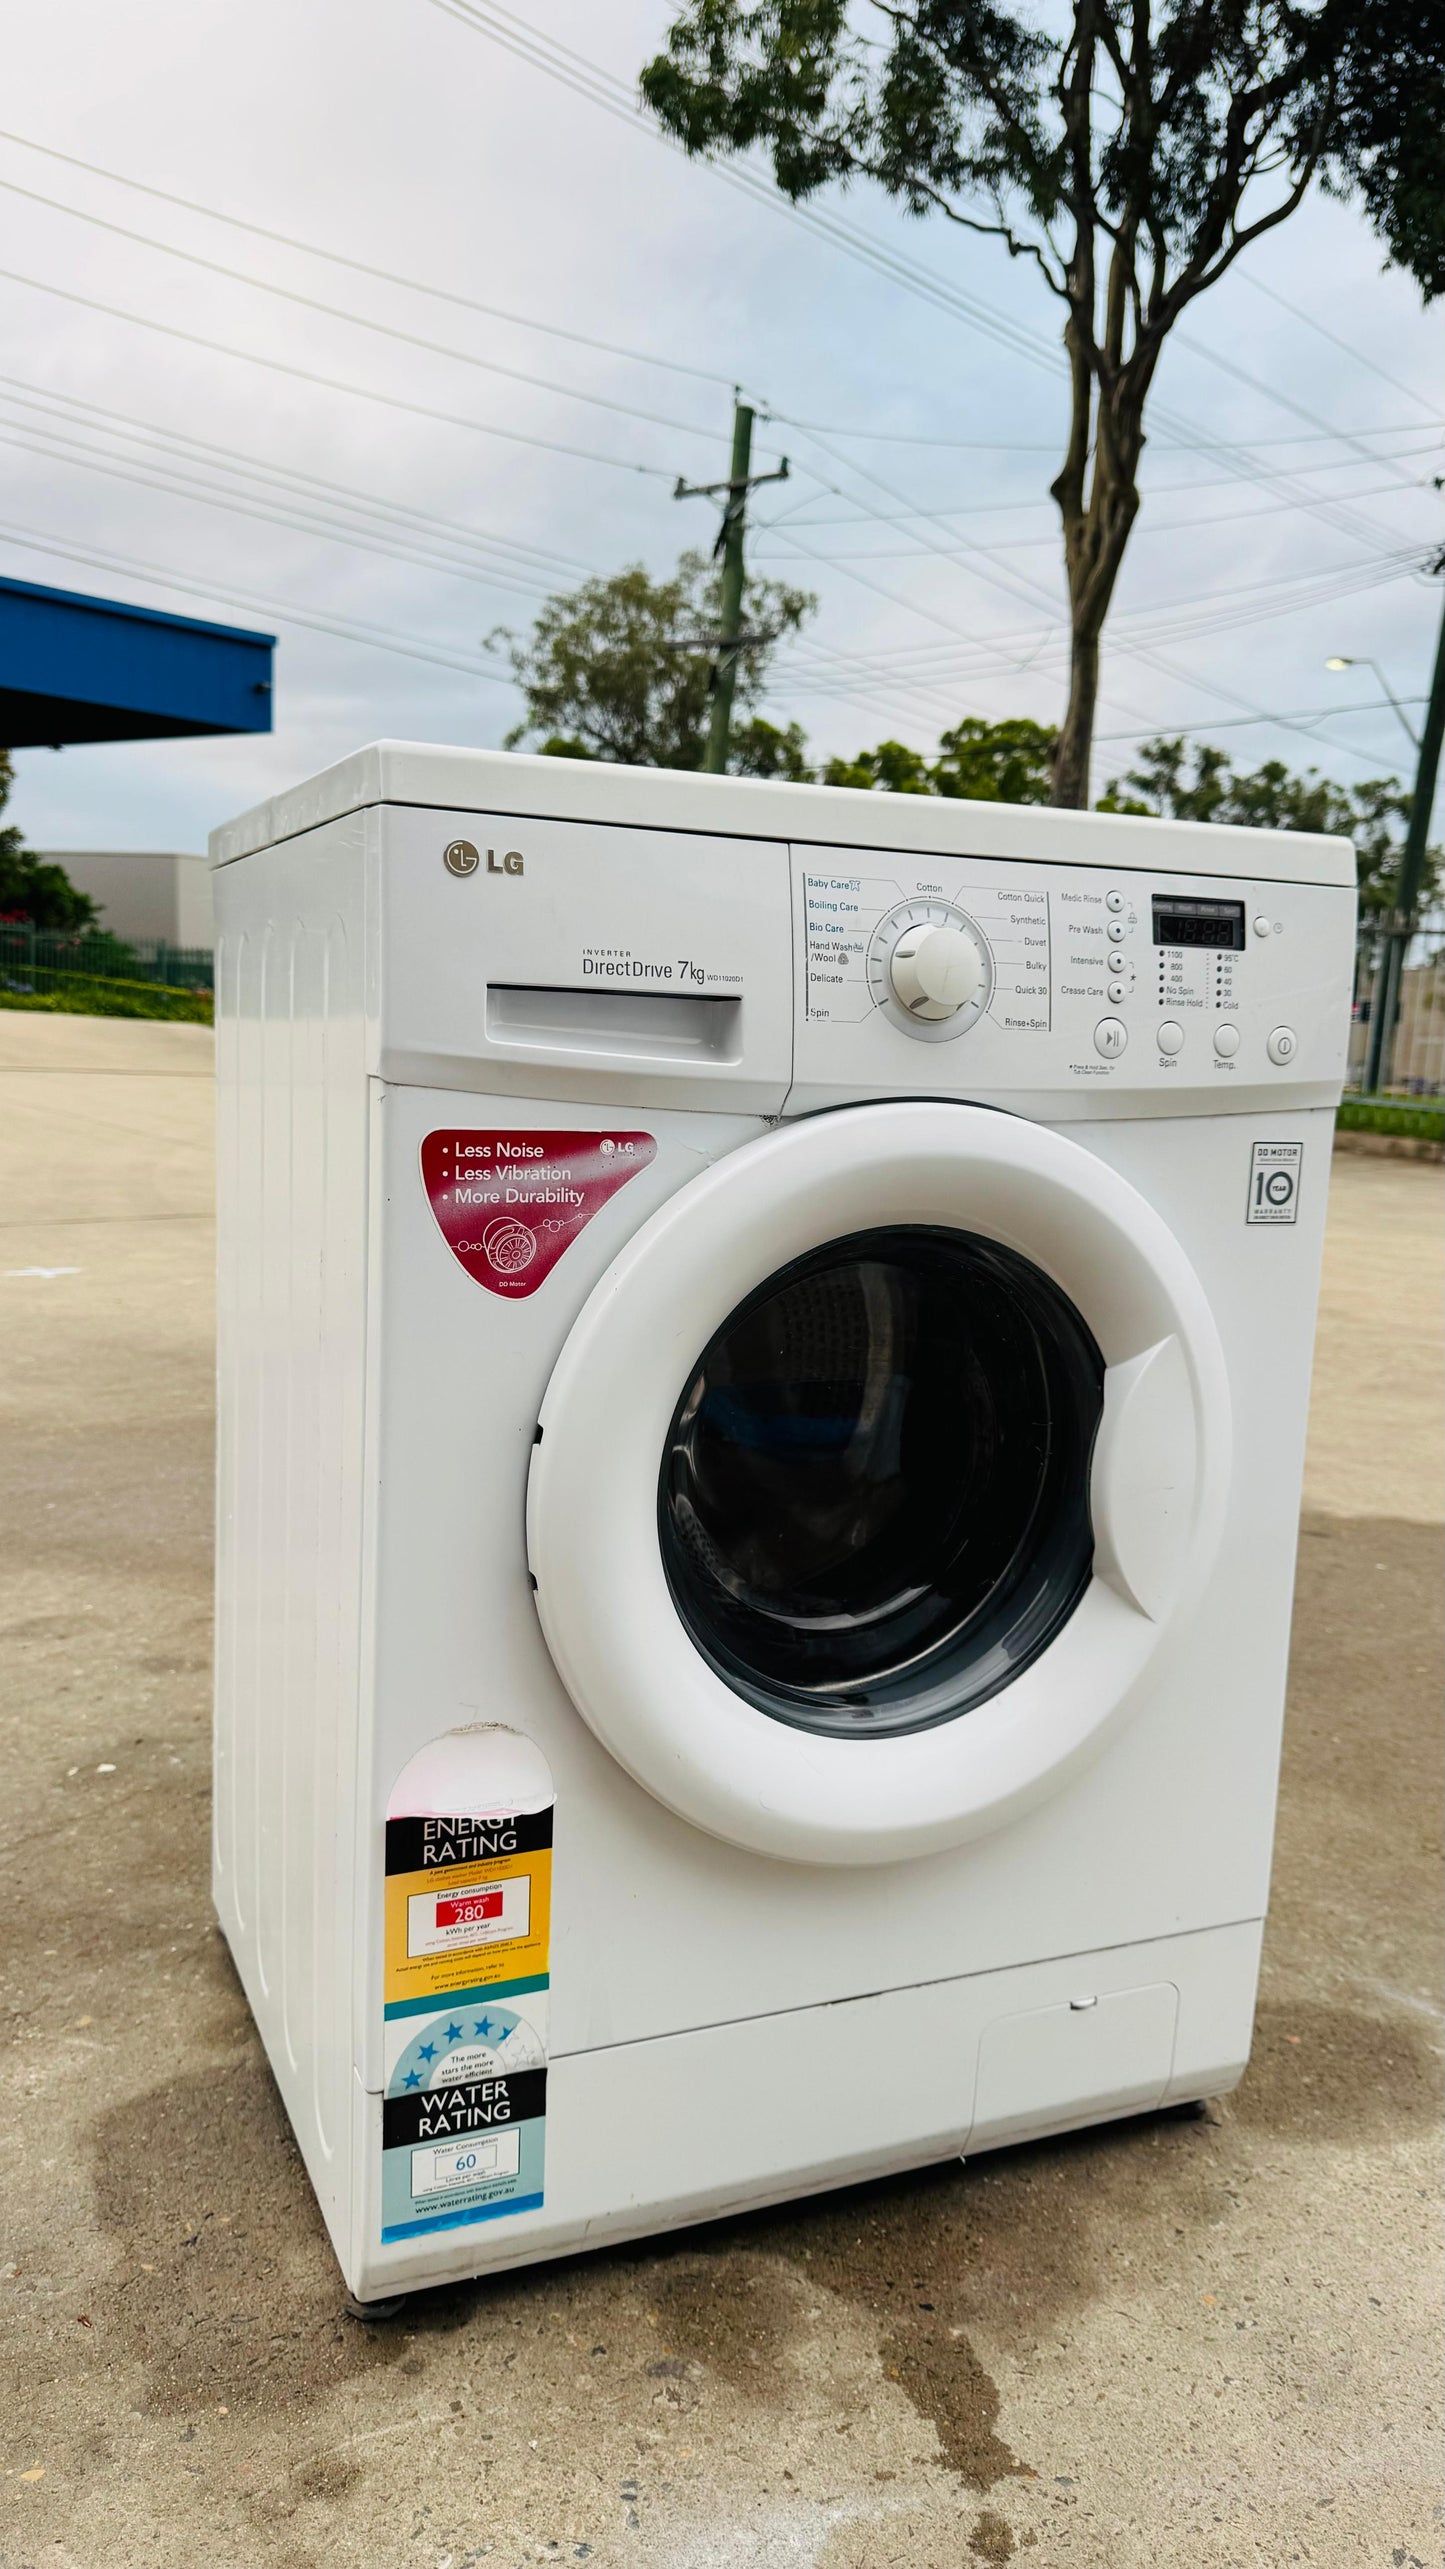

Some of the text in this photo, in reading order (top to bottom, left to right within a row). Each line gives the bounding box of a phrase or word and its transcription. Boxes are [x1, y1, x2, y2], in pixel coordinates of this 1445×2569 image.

[487, 849, 524, 876] LG
[807, 877, 850, 890] Baby Care
[916, 882, 943, 893] Cotton
[997, 891, 1045, 904] Cotton Quick
[1083, 893, 1103, 904] Rinse
[808, 899, 859, 912] Boiling Care
[1010, 914, 1047, 926] Synthetic
[809, 922, 845, 933] Bio Care
[1068, 924, 1103, 935] Pre Wash
[809, 940, 853, 952] Hand Wash
[1024, 936, 1047, 947] Duvet
[582, 948, 632, 958] INVERTER
[810, 952, 837, 963] /Wool
[1167, 950, 1183, 959] 1100
[1025, 960, 1047, 972] Bulky
[1070, 955, 1104, 966] Intensive
[810, 972, 844, 984] Delicate
[1015, 984, 1048, 995] Quick 30
[1060, 985, 1104, 997] Crease Care
[1166, 986, 1194, 996] No Spin
[1166, 997, 1204, 1008] Rinse Hold
[1222, 1001, 1239, 1010] Cold
[810, 1007, 830, 1019] Spin
[1158, 1057, 1177, 1069] Spin
[1212, 1059, 1236, 1071] Temp.
[455, 1141, 544, 1158] Less Noise
[617, 1142, 634, 1153] LG
[1270, 1148, 1298, 1157] MOTOR
[455, 1164, 572, 1181] Less Vibration
[1256, 1170, 1294, 1206] 10
[455, 1188, 585, 1207] More Durability
[423, 1830, 517, 1865] RATING
[436, 1883, 503, 1900] Energy consumption
[450, 1896, 490, 1909] Warm wash
[454, 1904, 485, 1924] 280
[445, 1928, 463, 1936] kWh
[476, 1922, 492, 1931] year
[451, 2052, 487, 2064] The more
[441, 2067, 459, 2076] stars
[474, 2059, 494, 2068] more
[441, 2068, 493, 2084] water efficient
[421, 2080, 509, 2114] WATER
[419, 2101, 511, 2138] RATING
[433, 2137, 499, 2155] Water Consumption
[455, 2153, 477, 2171] 60
[415, 2186, 515, 2214] www.waterrating.gov.au
